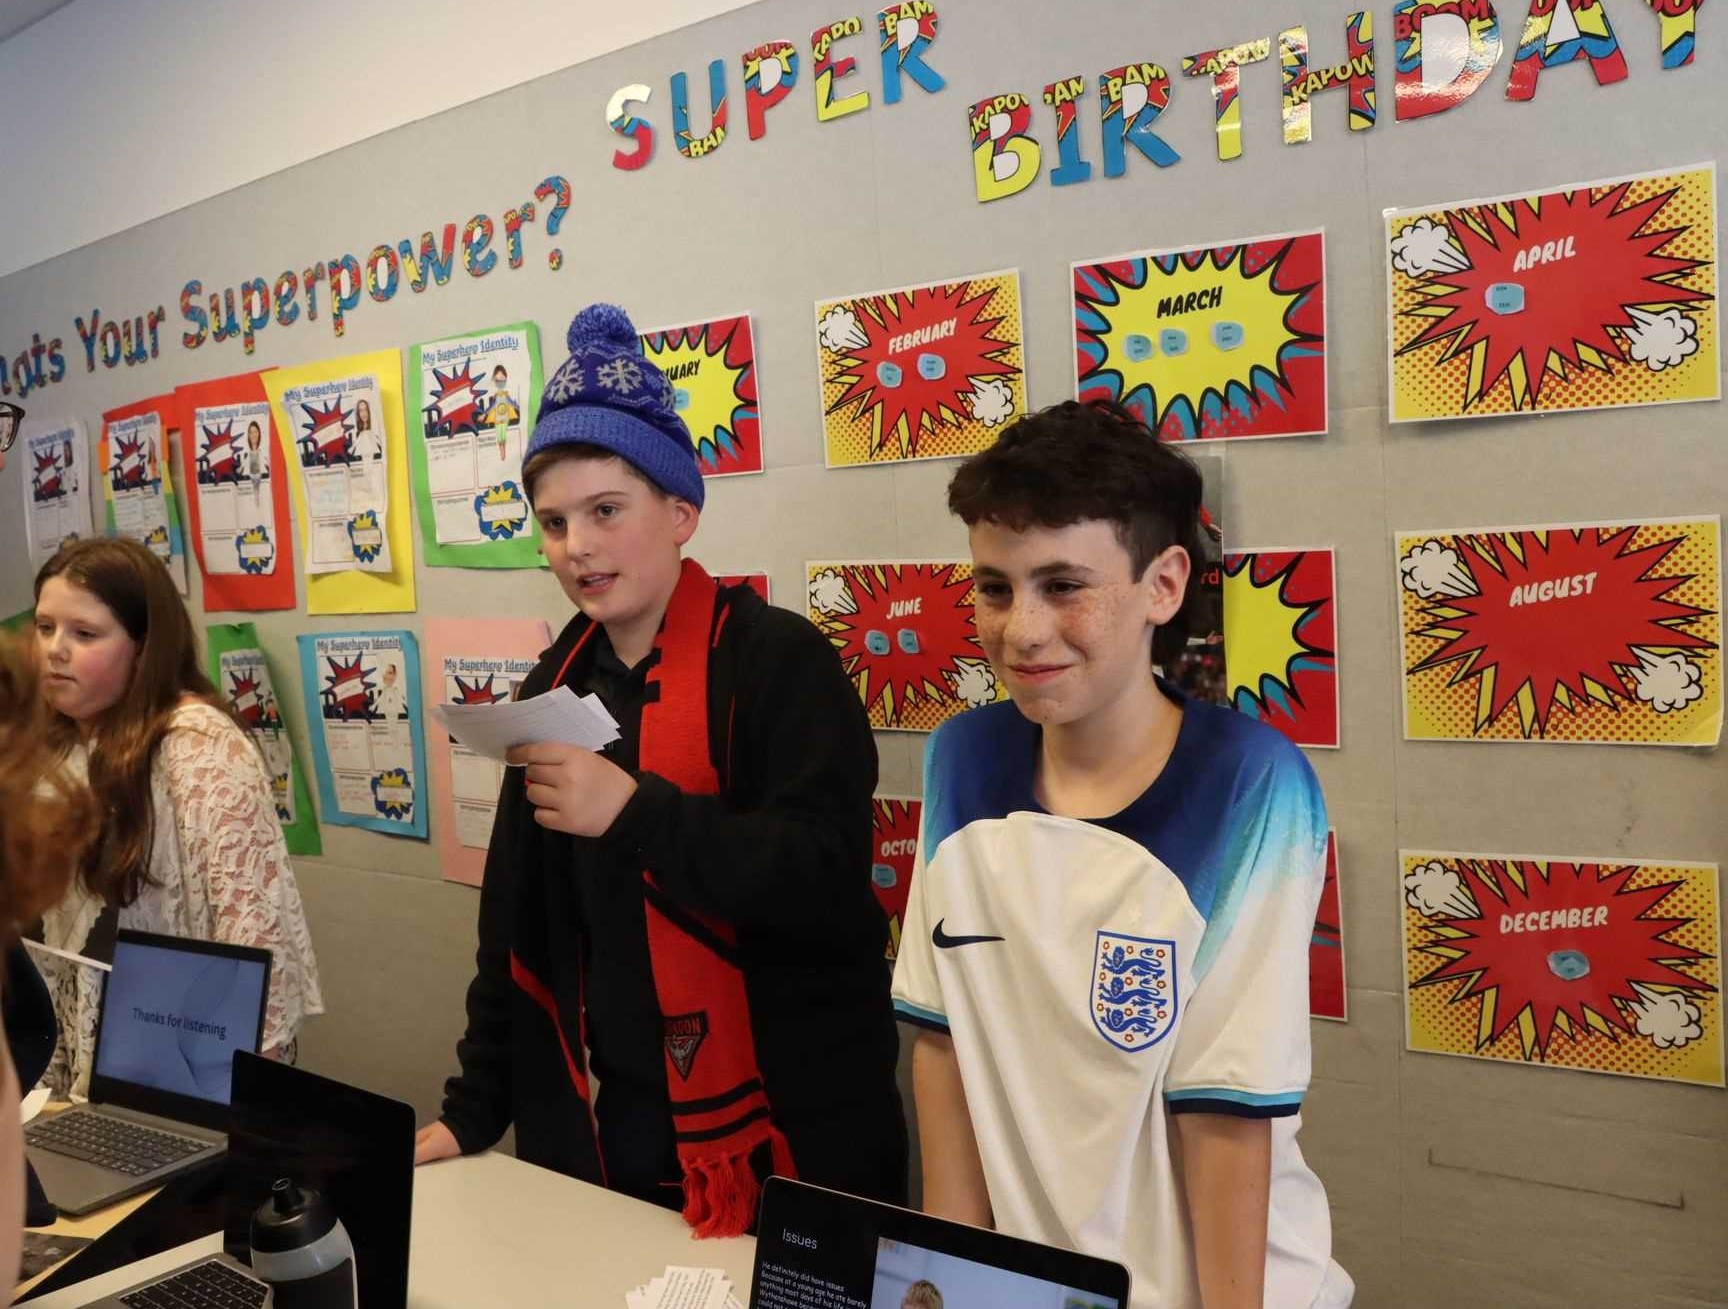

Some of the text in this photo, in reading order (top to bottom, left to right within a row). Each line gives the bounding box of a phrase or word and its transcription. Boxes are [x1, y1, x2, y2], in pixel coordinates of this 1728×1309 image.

[606, 0, 946, 171] SUPER
[1513, 236, 1576, 272] APRIL
[0, 175, 572, 398] ats Your Superpower?
[1157, 285, 1223, 318] MARCH
[480, 336, 519, 353] Identity
[888, 317, 958, 355] FEBRUARY
[665, 358, 701, 381] UARY
[1200, 568, 1220, 585] rd
[1509, 571, 1598, 607] AUGUST
[885, 597, 923, 620] JUNE
[505, 658, 536, 673] Identit
[881, 838, 917, 857] OCTO
[1499, 905, 1609, 934] DECEMBER
[133, 1007, 227, 1040] Thanks for listening
[782, 1228, 817, 1249] Issues
